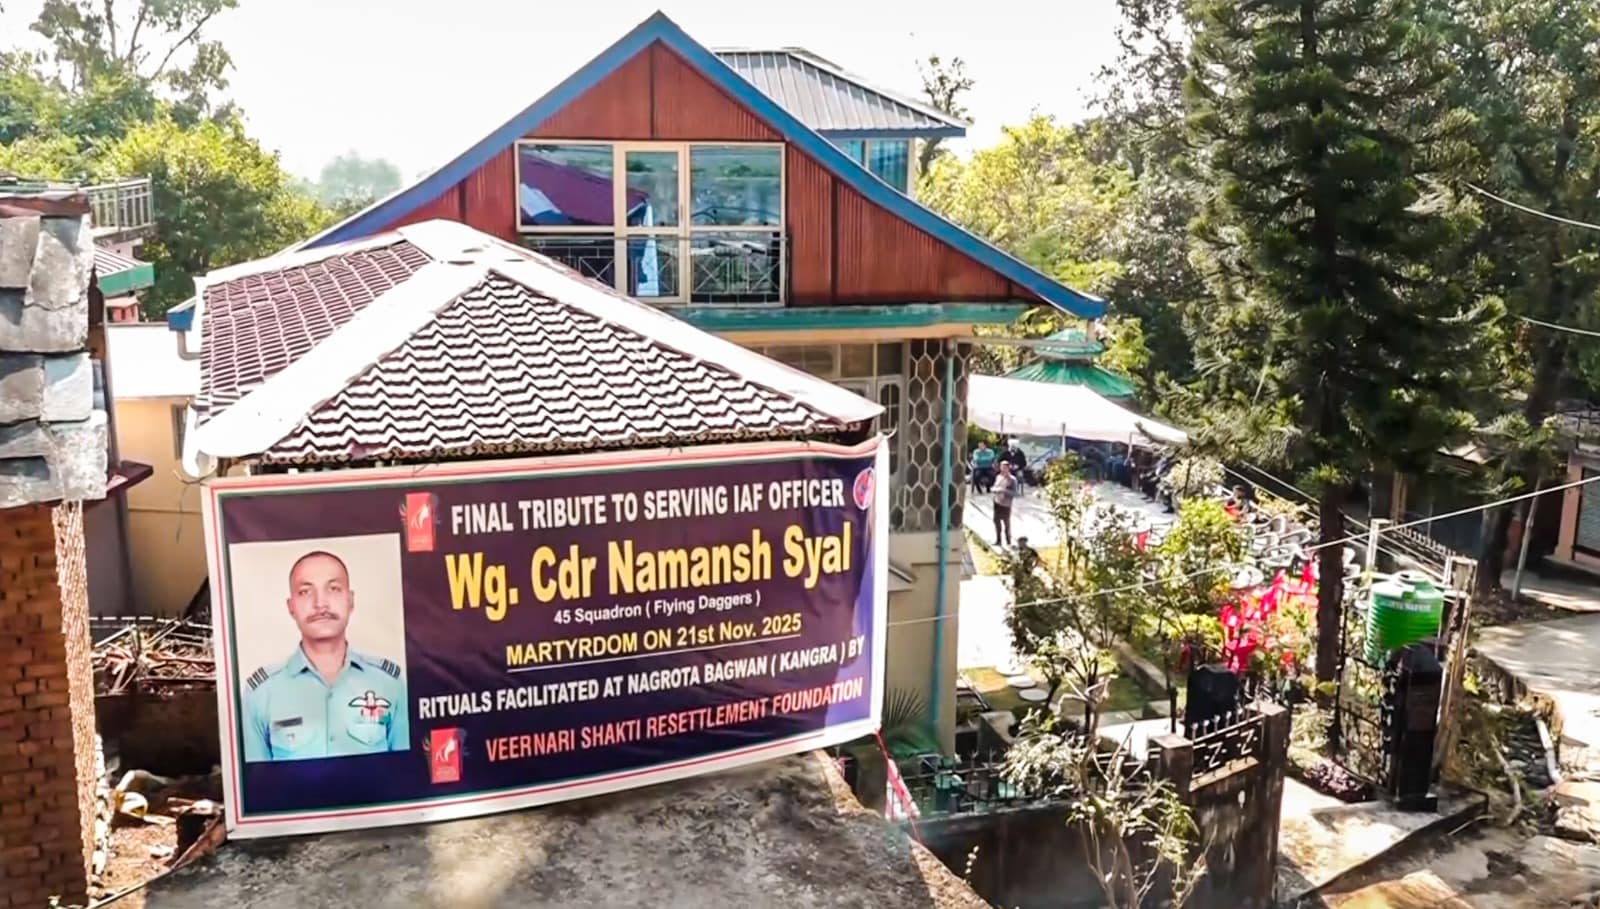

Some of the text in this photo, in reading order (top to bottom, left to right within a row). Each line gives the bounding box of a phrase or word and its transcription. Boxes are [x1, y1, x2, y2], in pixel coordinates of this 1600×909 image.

[451, 479, 845, 535] FINAL TRIBUTE TO SERVING IAF OFFICER
[445, 521, 851, 621] Wg. Cdr Namansh Syal
[506, 613, 802, 666] MARTYRDOM ON 21st Nov. 2025
[554, 609, 571, 624] 45
[574, 602, 642, 625] Squadron
[654, 598, 695, 616] Flying
[699, 591, 752, 610] Daggers
[419, 691, 492, 719] RITUALS
[497, 679, 599, 711] FACILITATED
[603, 674, 624, 698] AT
[628, 666, 700, 694] NAGROTA
[704, 657, 767, 684] BAGWAN
[780, 644, 837, 670] KANGRA
[848, 635, 865, 658] BY
[486, 677, 863, 762] VEERNARI SHAKTI RESETTLEMENT FOUNDATION
